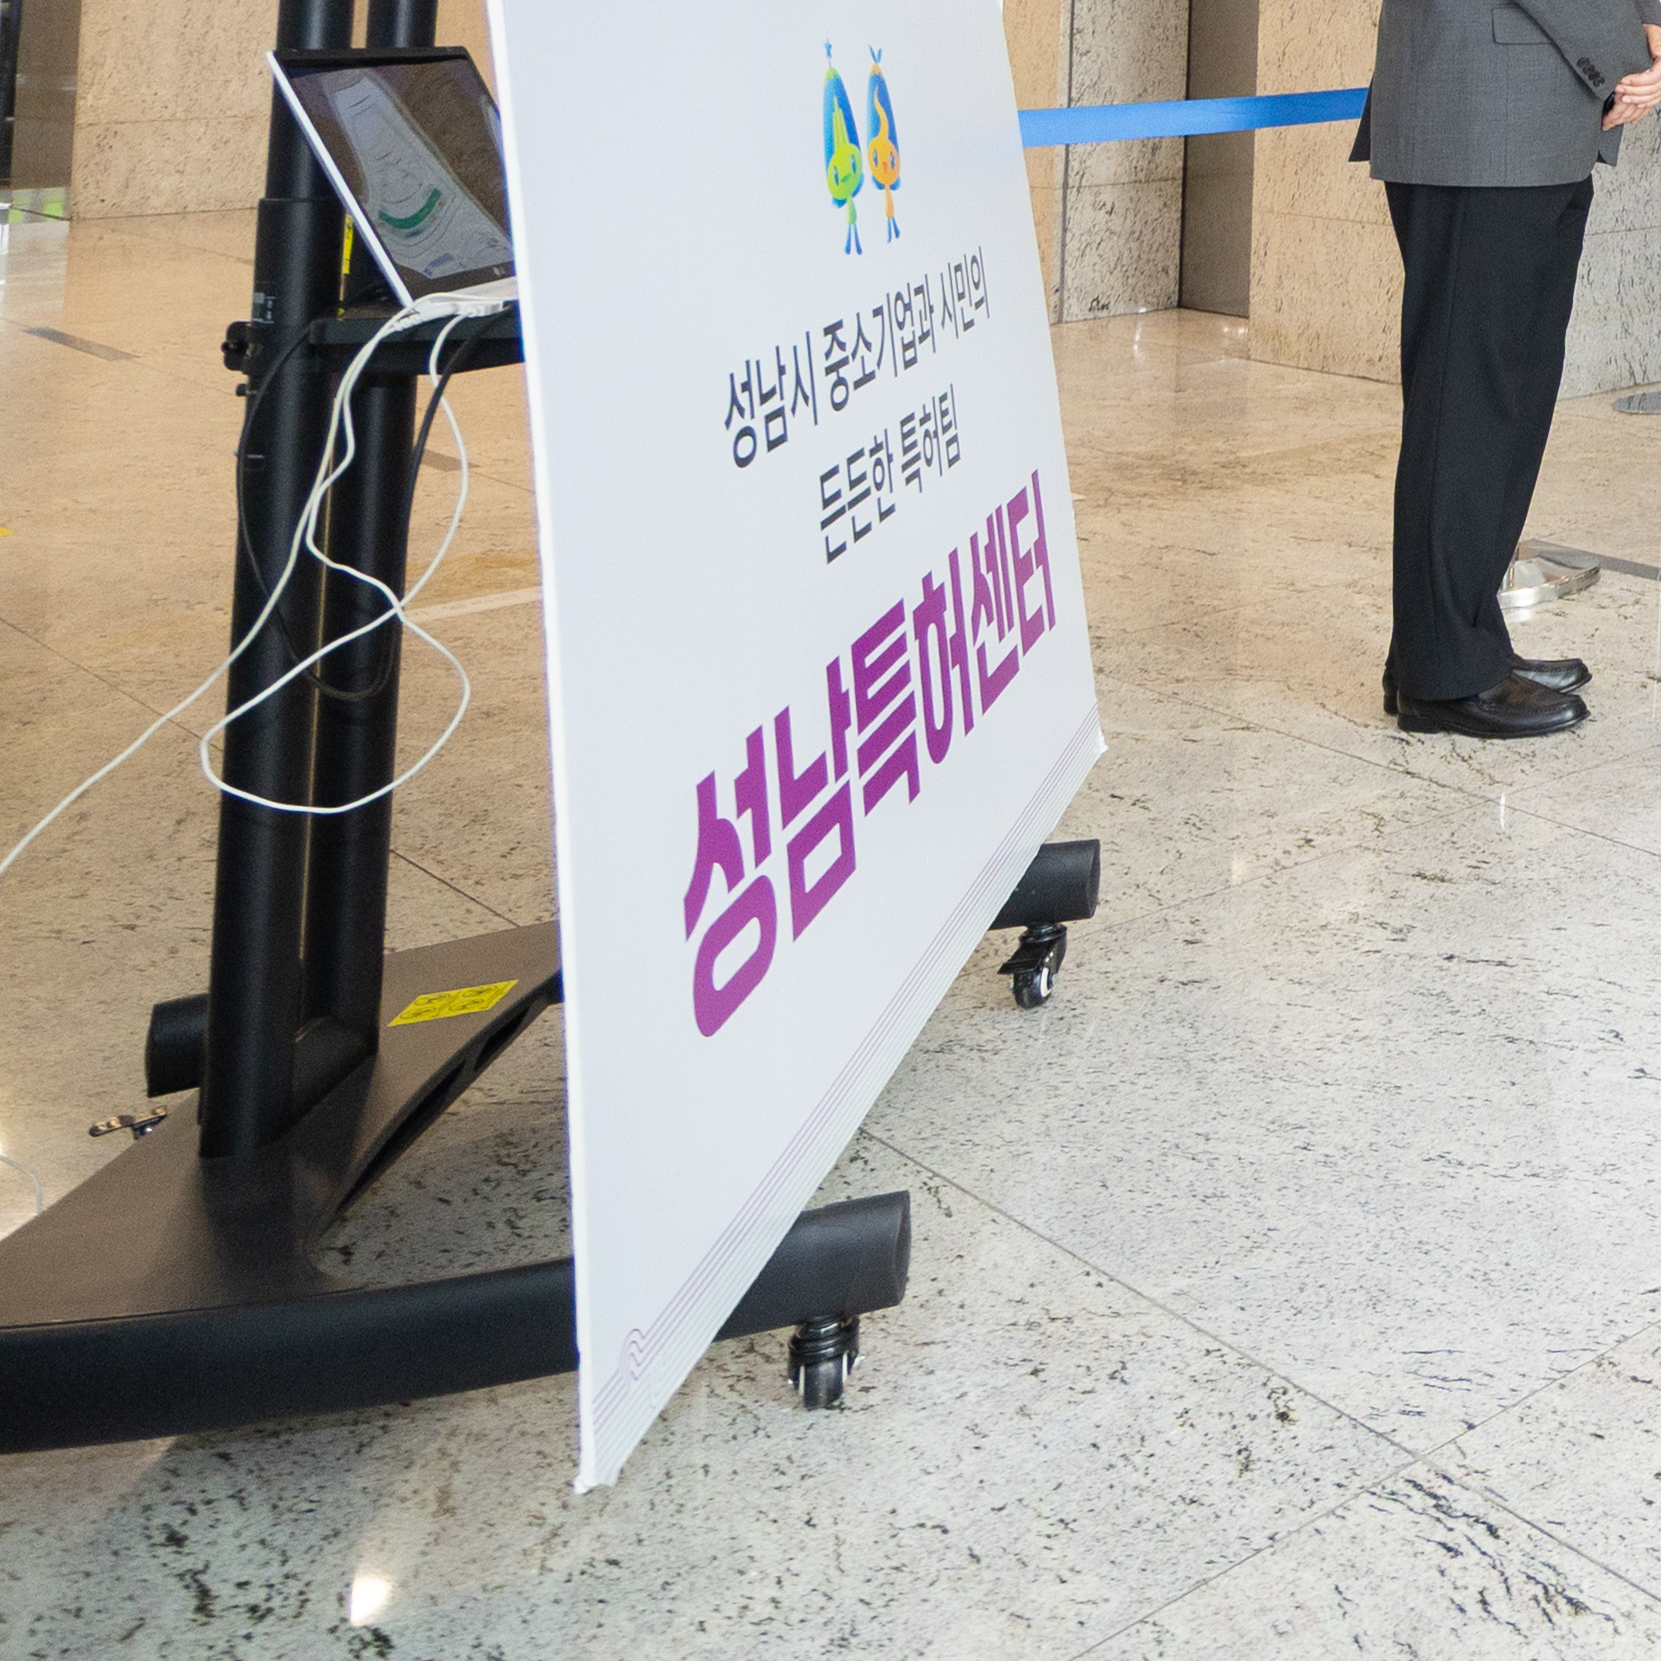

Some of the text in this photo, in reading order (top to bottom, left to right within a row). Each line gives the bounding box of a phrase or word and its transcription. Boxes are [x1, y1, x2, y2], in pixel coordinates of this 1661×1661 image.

[724, 246, 991, 469] 성남시 중소기업과 시민의
[819, 384, 962, 565] 든든한 특허팀
[683, 469, 1057, 1038] 성남특허센터
